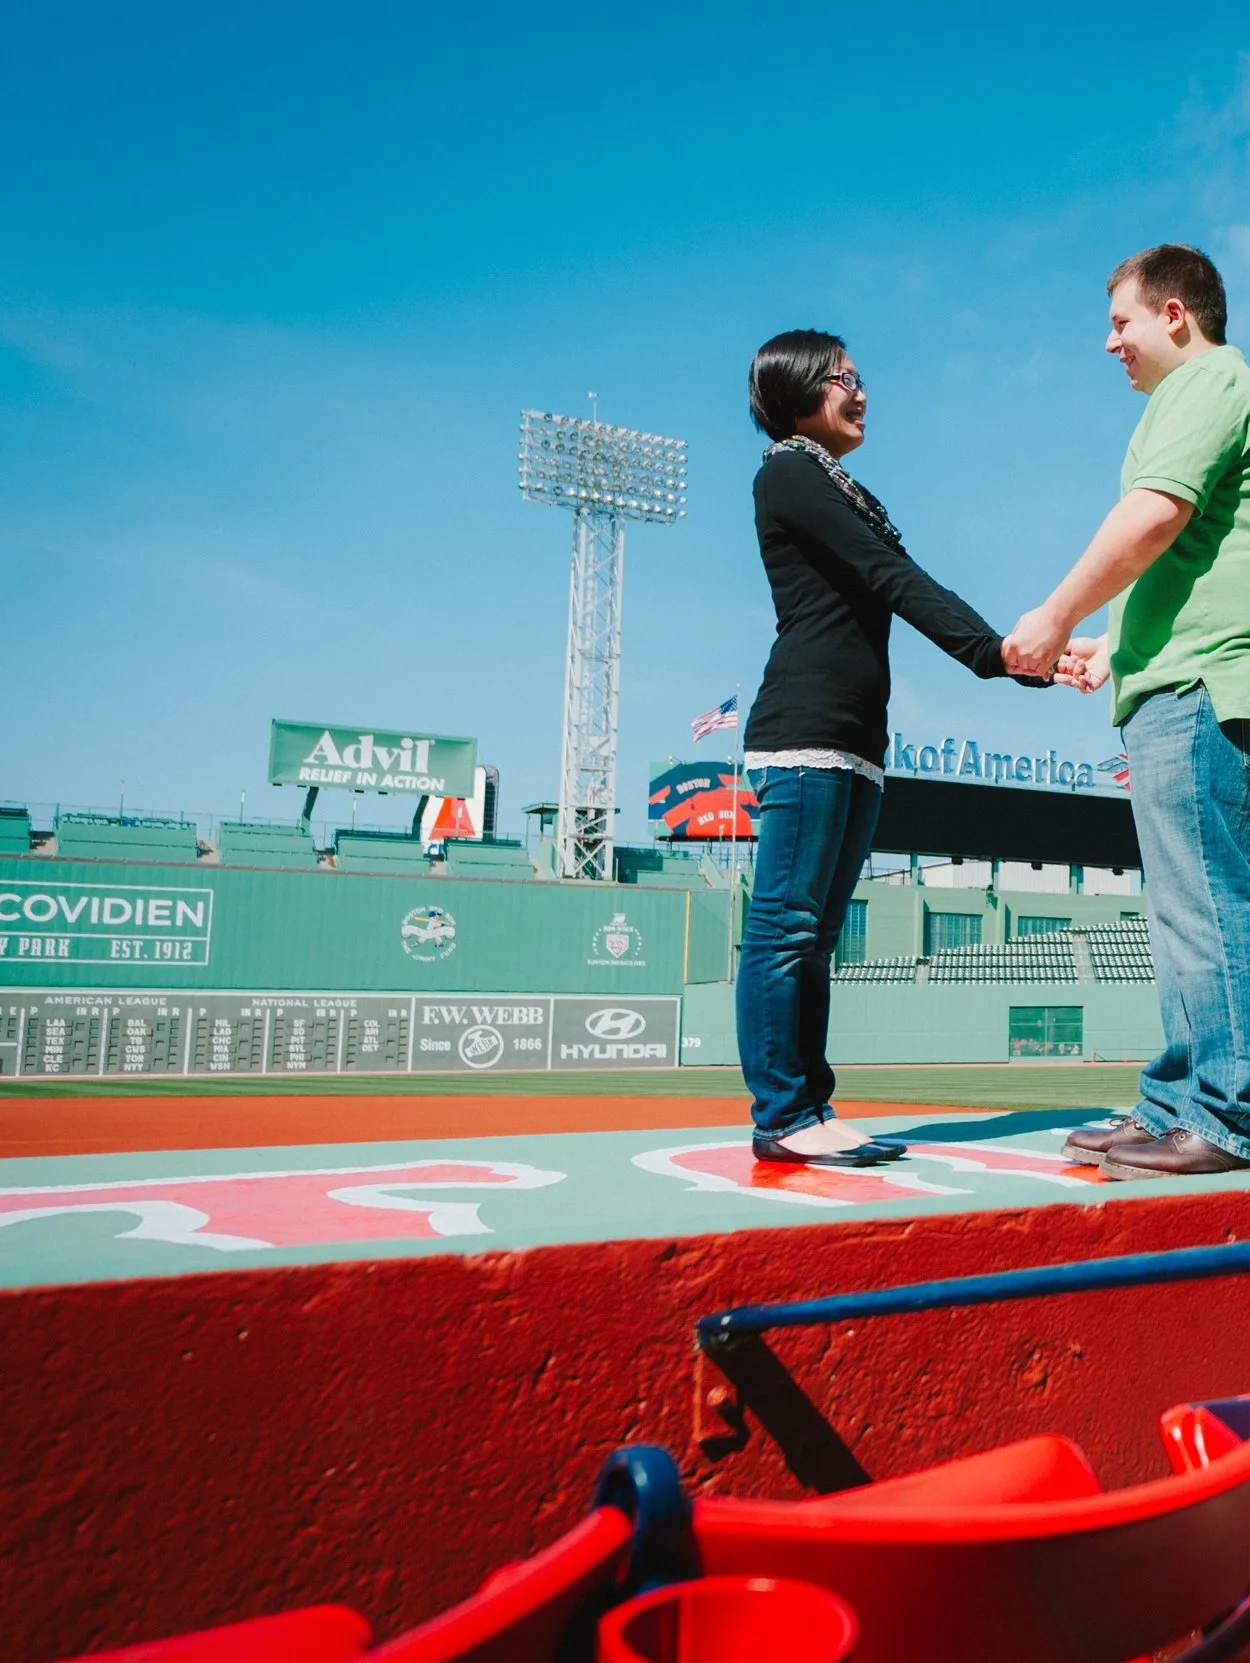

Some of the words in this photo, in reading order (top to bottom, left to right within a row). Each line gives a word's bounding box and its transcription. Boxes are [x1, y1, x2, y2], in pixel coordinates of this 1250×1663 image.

[303, 730, 432, 773] Advil
[300, 767, 352, 783] RELIEF
[357, 771, 377, 785] IN
[379, 775, 445, 791] ACTION
[698, 812, 714, 825] RED
[0, 893, 204, 927] COVIDIEN
[18, 937, 70, 957] PARK
[110, 940, 148, 959] EST.
[155, 941, 192, 960] 1912
[44, 997, 113, 1005] AMERICAN
[119, 997, 167, 1006] LEAGUE
[252, 999, 308, 1007] NATIONAL
[471, 1006, 544, 1025] WEBB
[293, 1020, 304, 1028] SF
[364, 1020, 380, 1028] COL
[46, 1028, 65, 1036] SEA
[127, 1028, 146, 1036] OAK
[213, 1028, 231, 1036] LAD
[420, 1038, 451, 1051] Since
[513, 1038, 542, 1051] 1866
[682, 1037, 701, 1048] 379
[125, 1046, 145, 1054] CWS
[213, 1046, 229, 1054] MIA
[560, 1044, 667, 1060] HYUNDAI
[213, 1054, 228, 1062] CIN
[45, 1064, 59, 1072] KC
[124, 1064, 142, 1072] NYY
